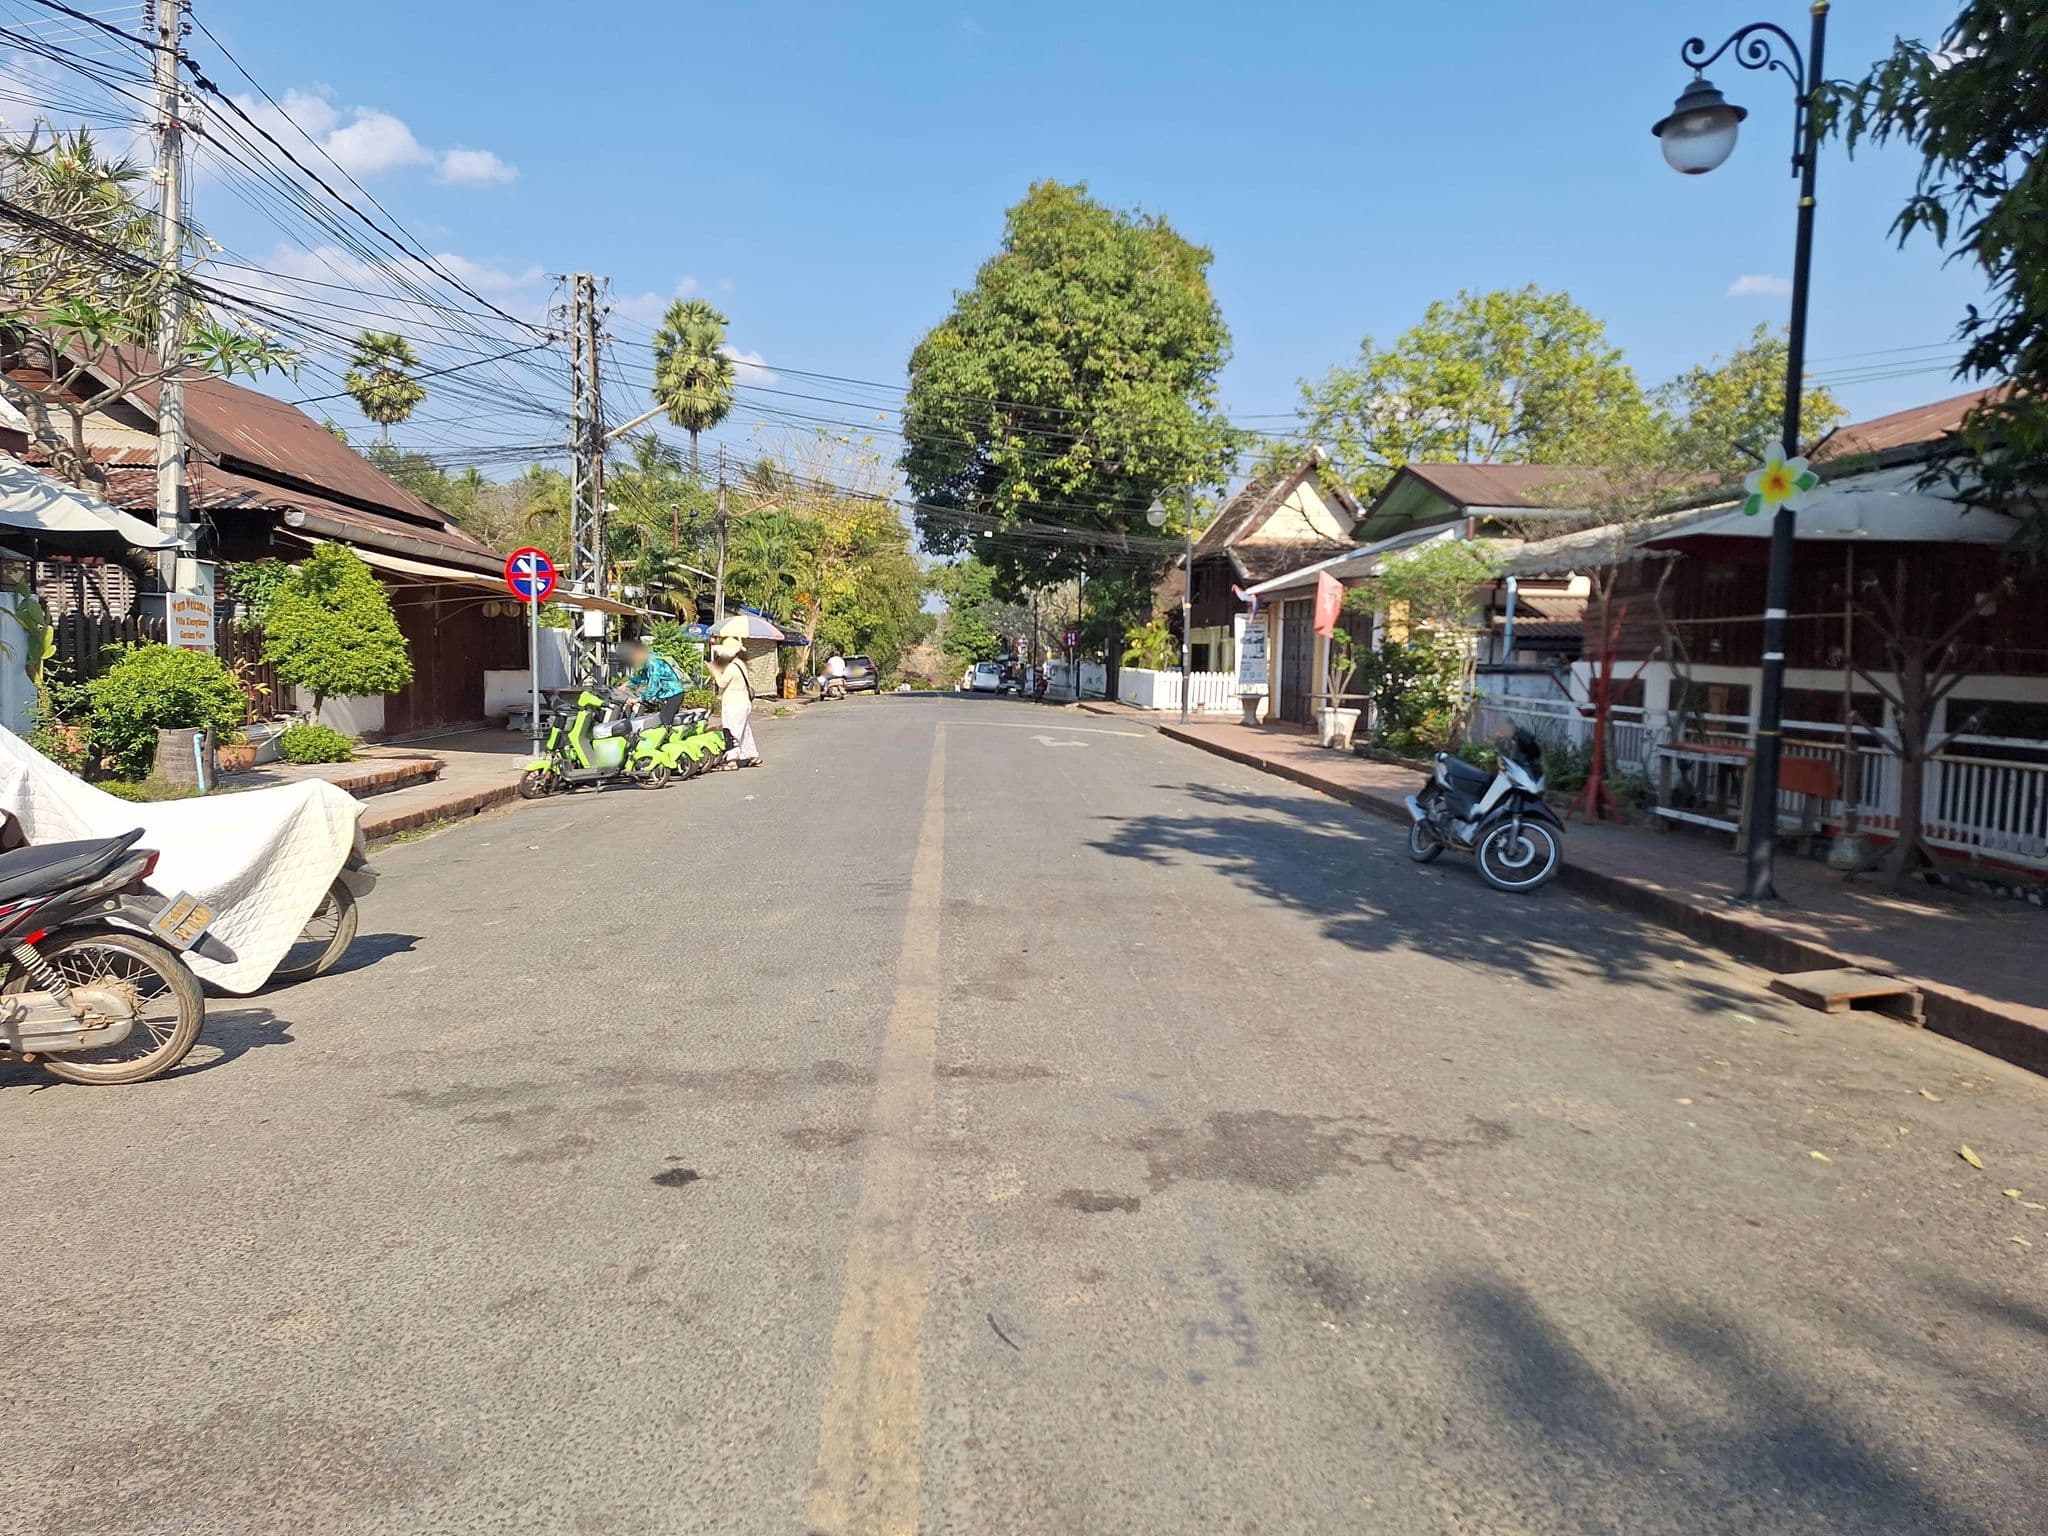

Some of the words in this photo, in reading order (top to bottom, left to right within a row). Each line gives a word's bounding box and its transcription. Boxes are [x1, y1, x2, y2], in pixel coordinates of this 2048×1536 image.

[172, 599, 185, 612] Warm
[185, 597, 206, 613] Welcome
[176, 616, 185, 625] Villa
[180, 630, 195, 639] Garden
[195, 630, 205, 639] View
